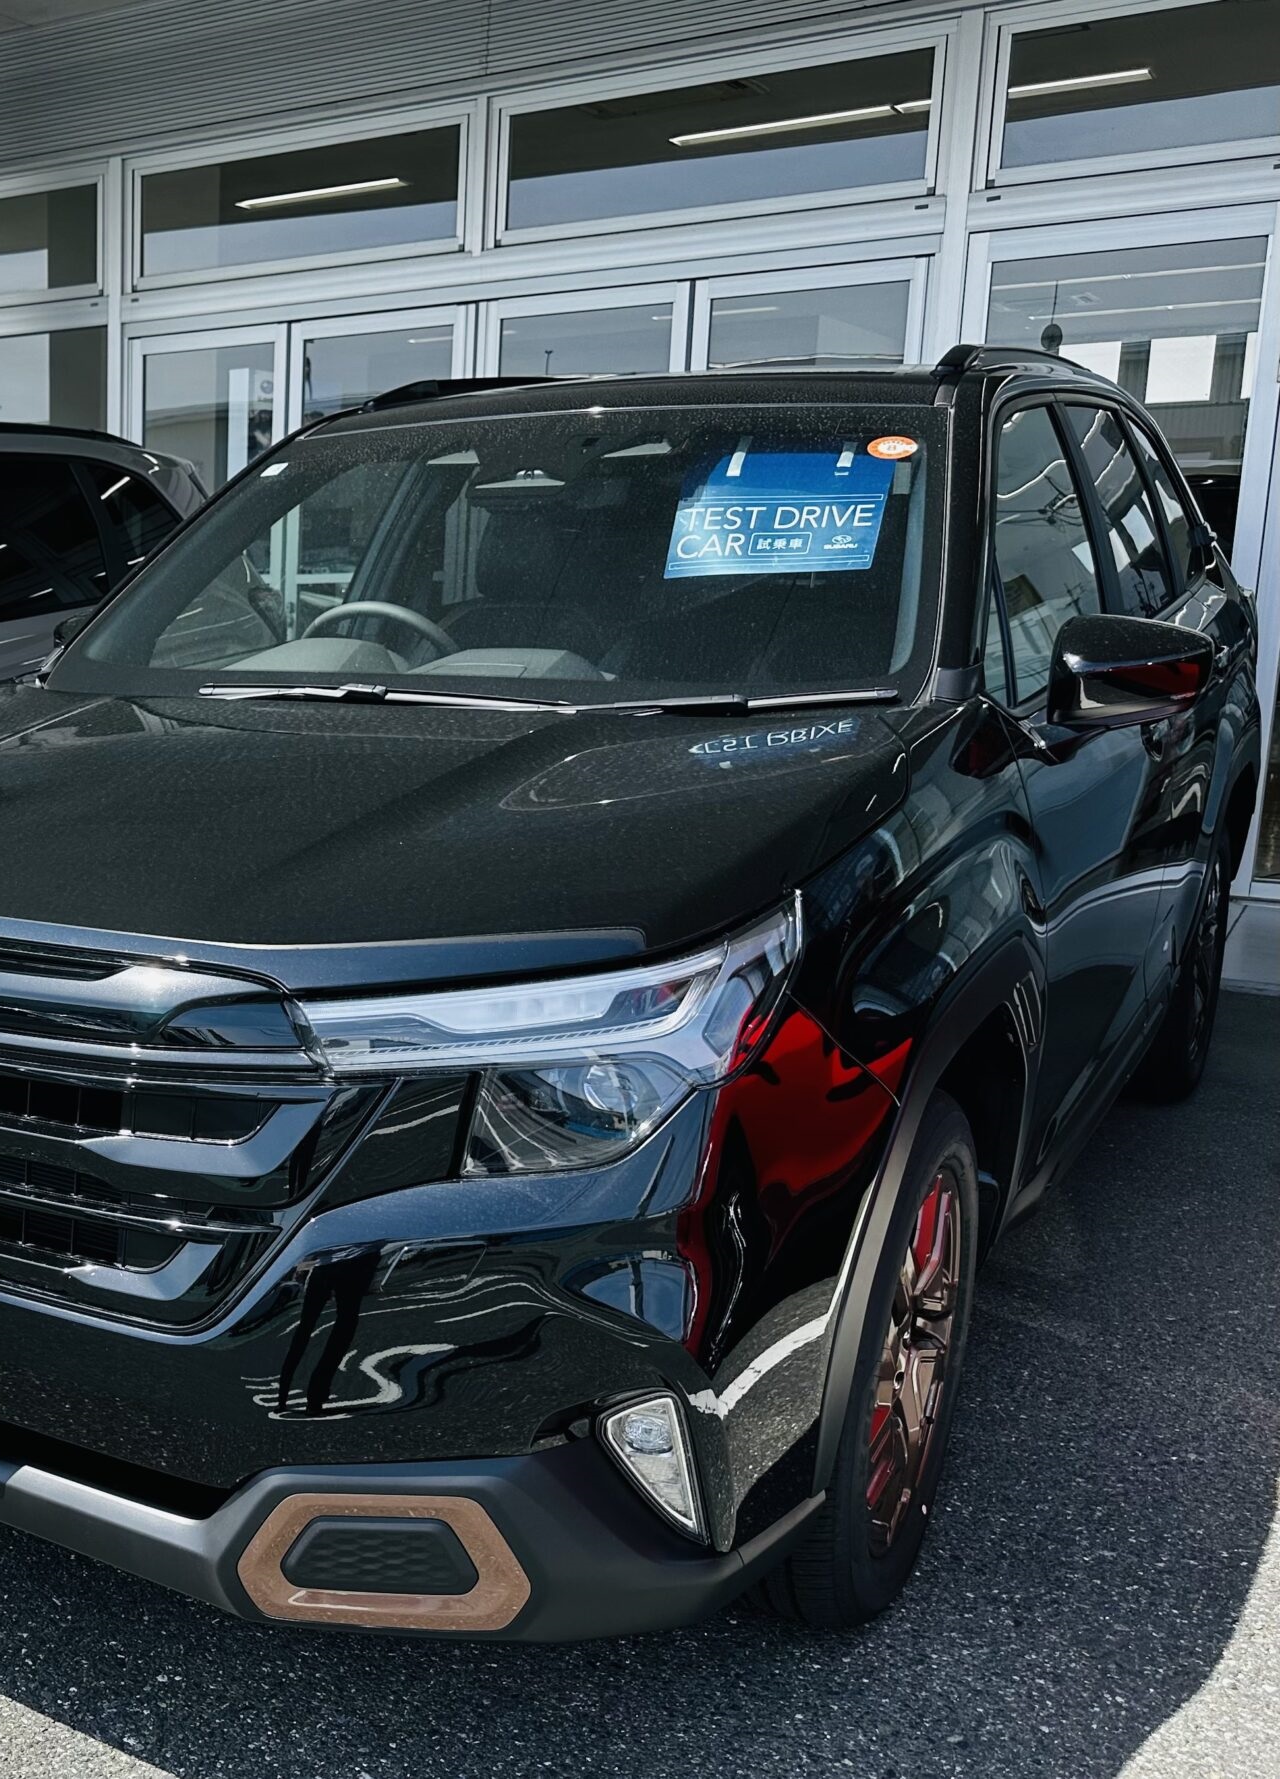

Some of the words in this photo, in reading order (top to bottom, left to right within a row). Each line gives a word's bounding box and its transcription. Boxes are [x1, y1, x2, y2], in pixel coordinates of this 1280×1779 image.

[682, 506, 767, 532] TEST
[773, 504, 876, 529] DRIVE
[676, 533, 746, 559] CAR
[756, 537, 804, 551] 試乗車
